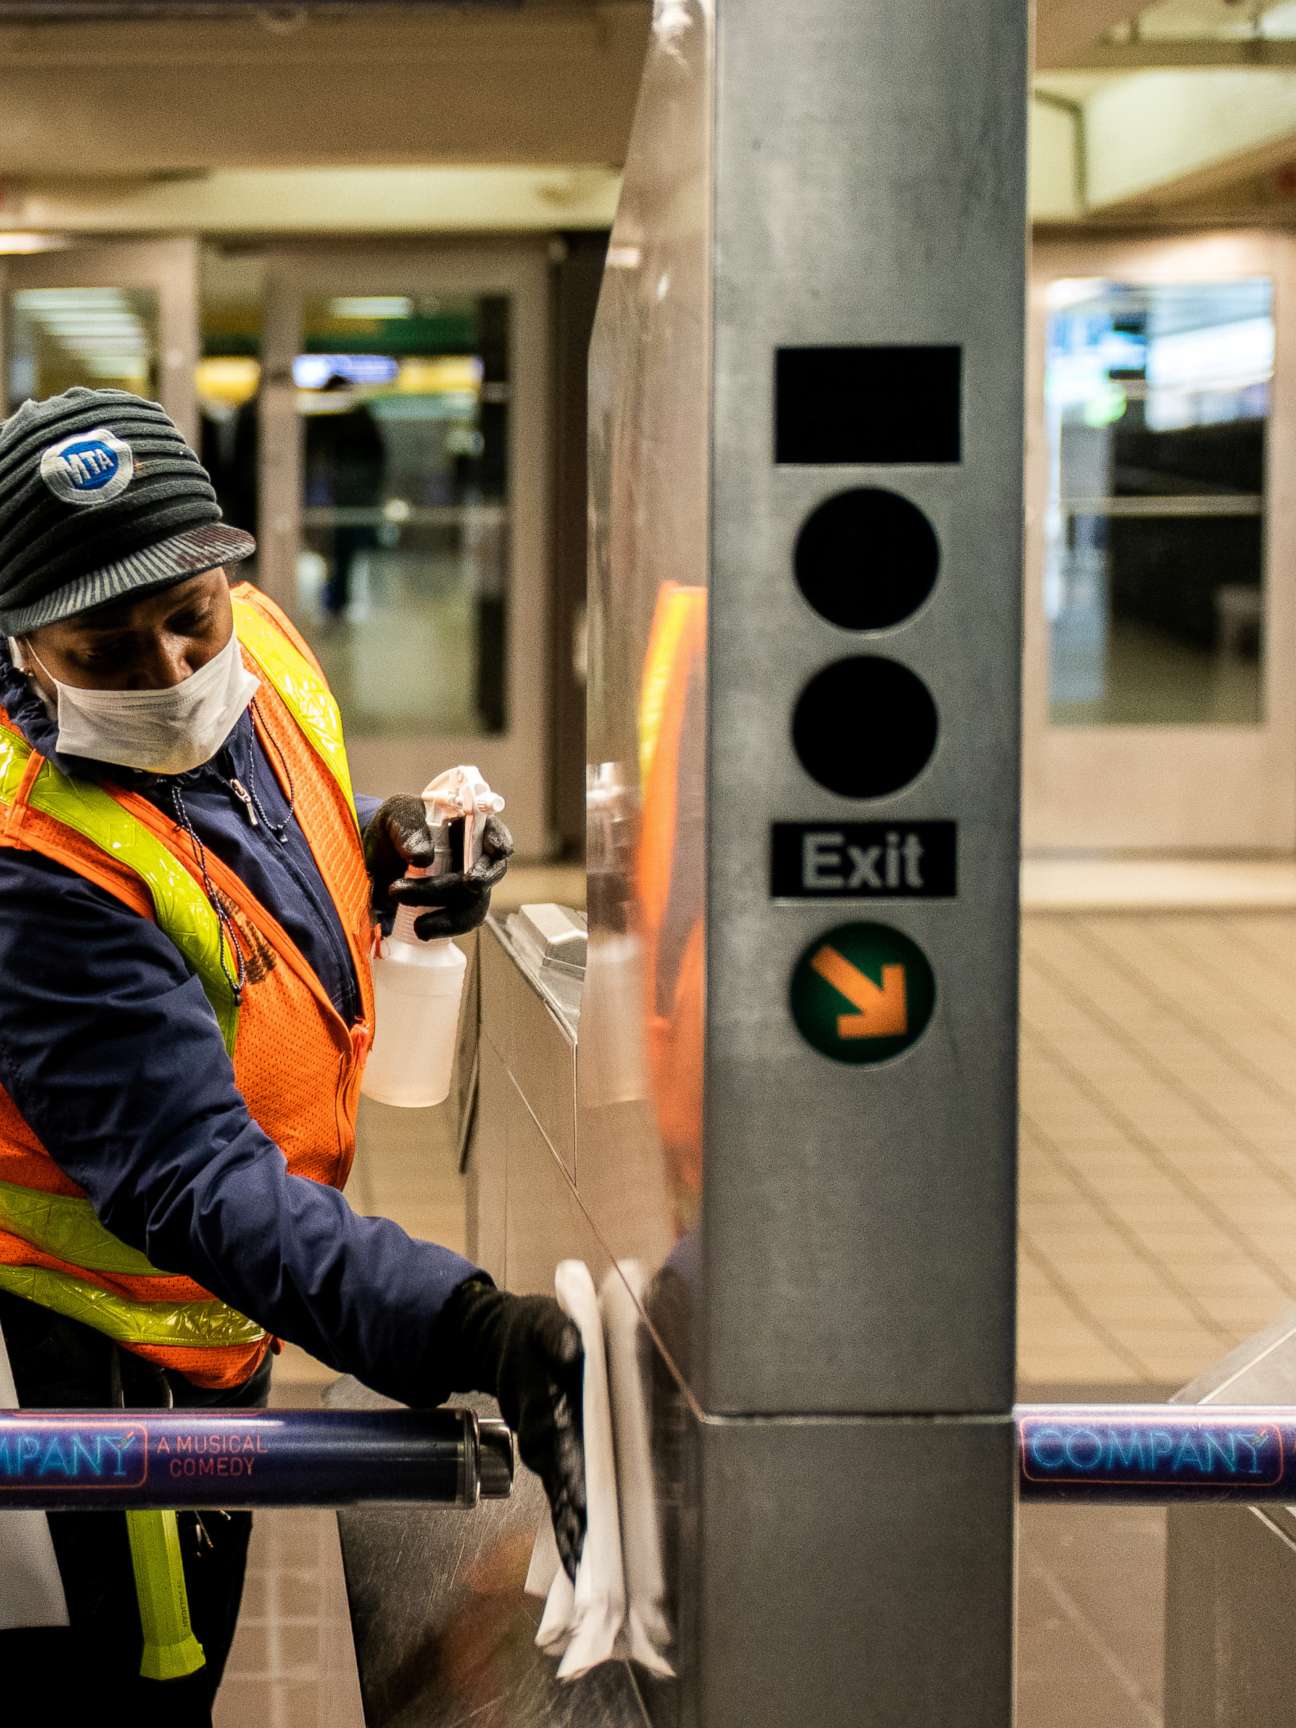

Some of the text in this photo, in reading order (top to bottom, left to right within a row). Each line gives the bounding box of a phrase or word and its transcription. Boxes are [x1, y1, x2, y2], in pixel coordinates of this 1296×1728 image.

[55, 448, 115, 487] MTA
[802, 831, 925, 889] Exit
[156, 1434, 269, 1456] A MUSICAL
[1030, 1427, 1271, 1475] COMPANY
[169, 1457, 255, 1478] COMEDY
